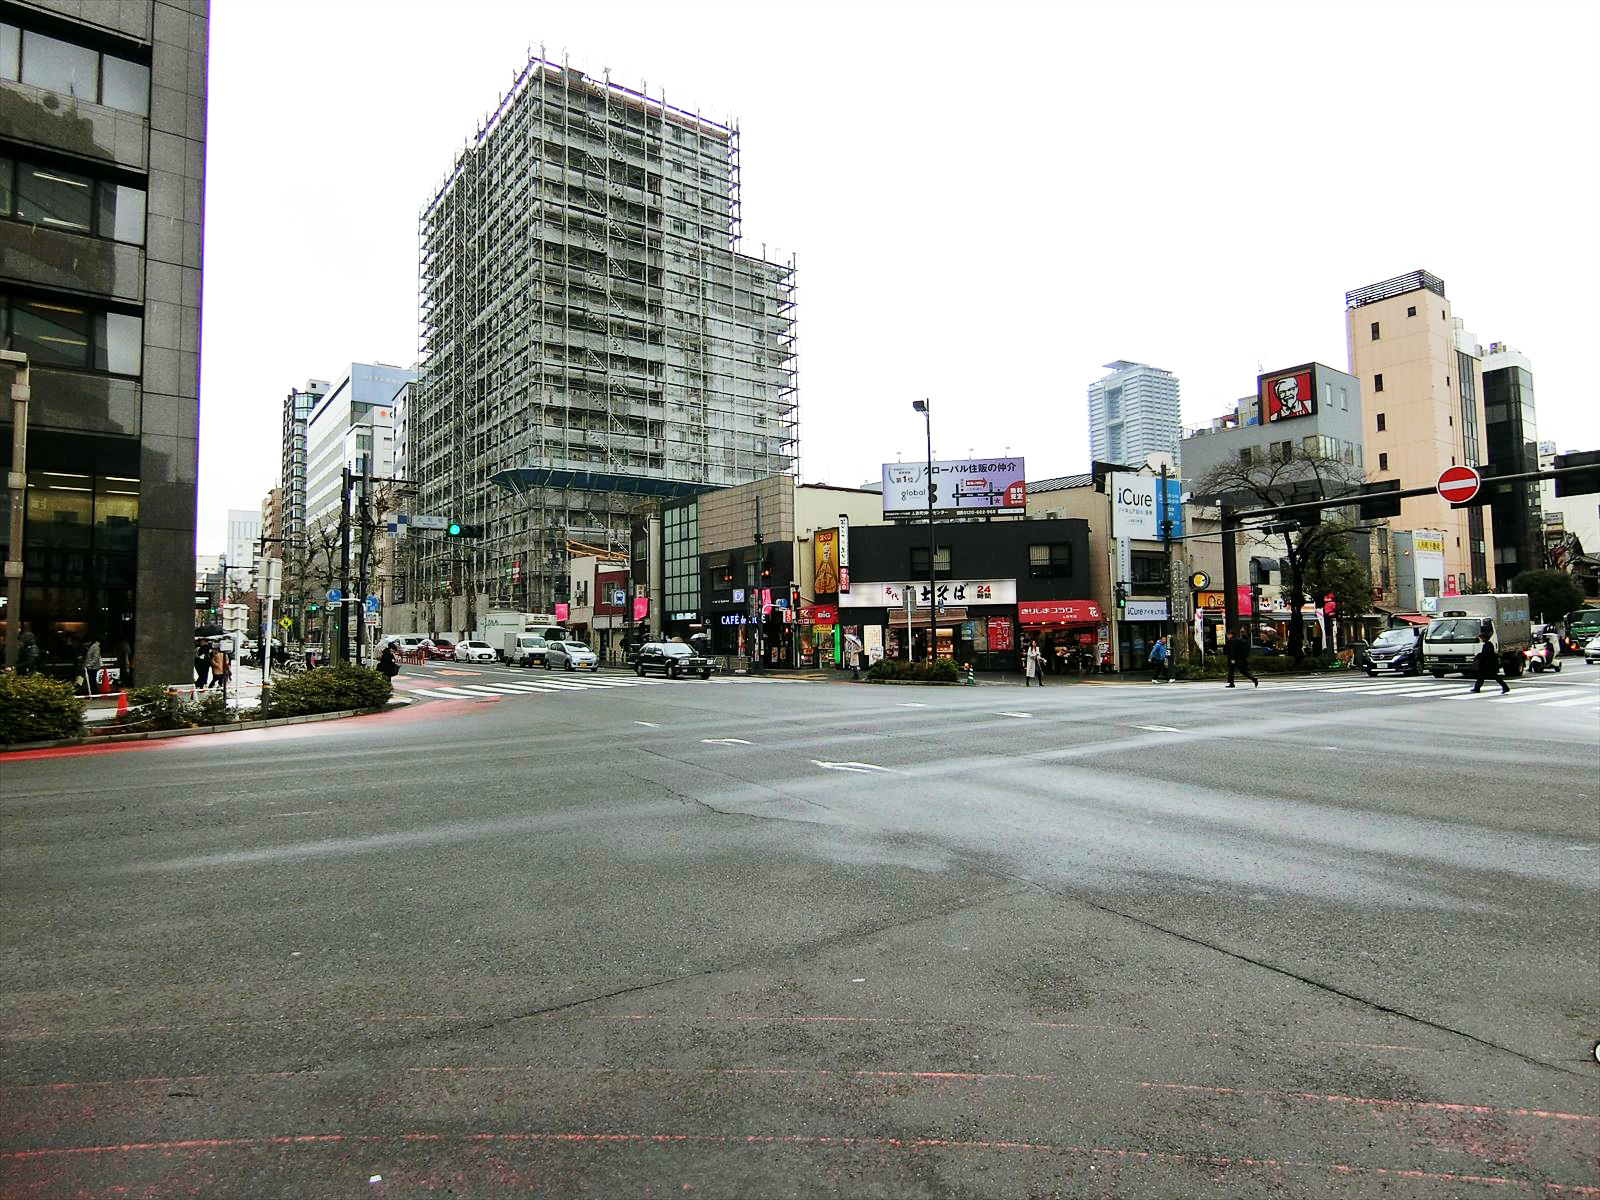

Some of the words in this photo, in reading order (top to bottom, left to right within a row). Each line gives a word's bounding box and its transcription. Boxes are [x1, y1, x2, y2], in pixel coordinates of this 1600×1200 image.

[923, 462, 1017, 476] グローバル住販の仲介
[901, 489, 926, 501] global
[1118, 487, 1153, 507] iCure
[977, 585, 991, 593] 24
[1021, 607, 1080, 615] きりしまフラワー
[1087, 606, 1099, 617] 花
[721, 613, 740, 624] CAFÉ
